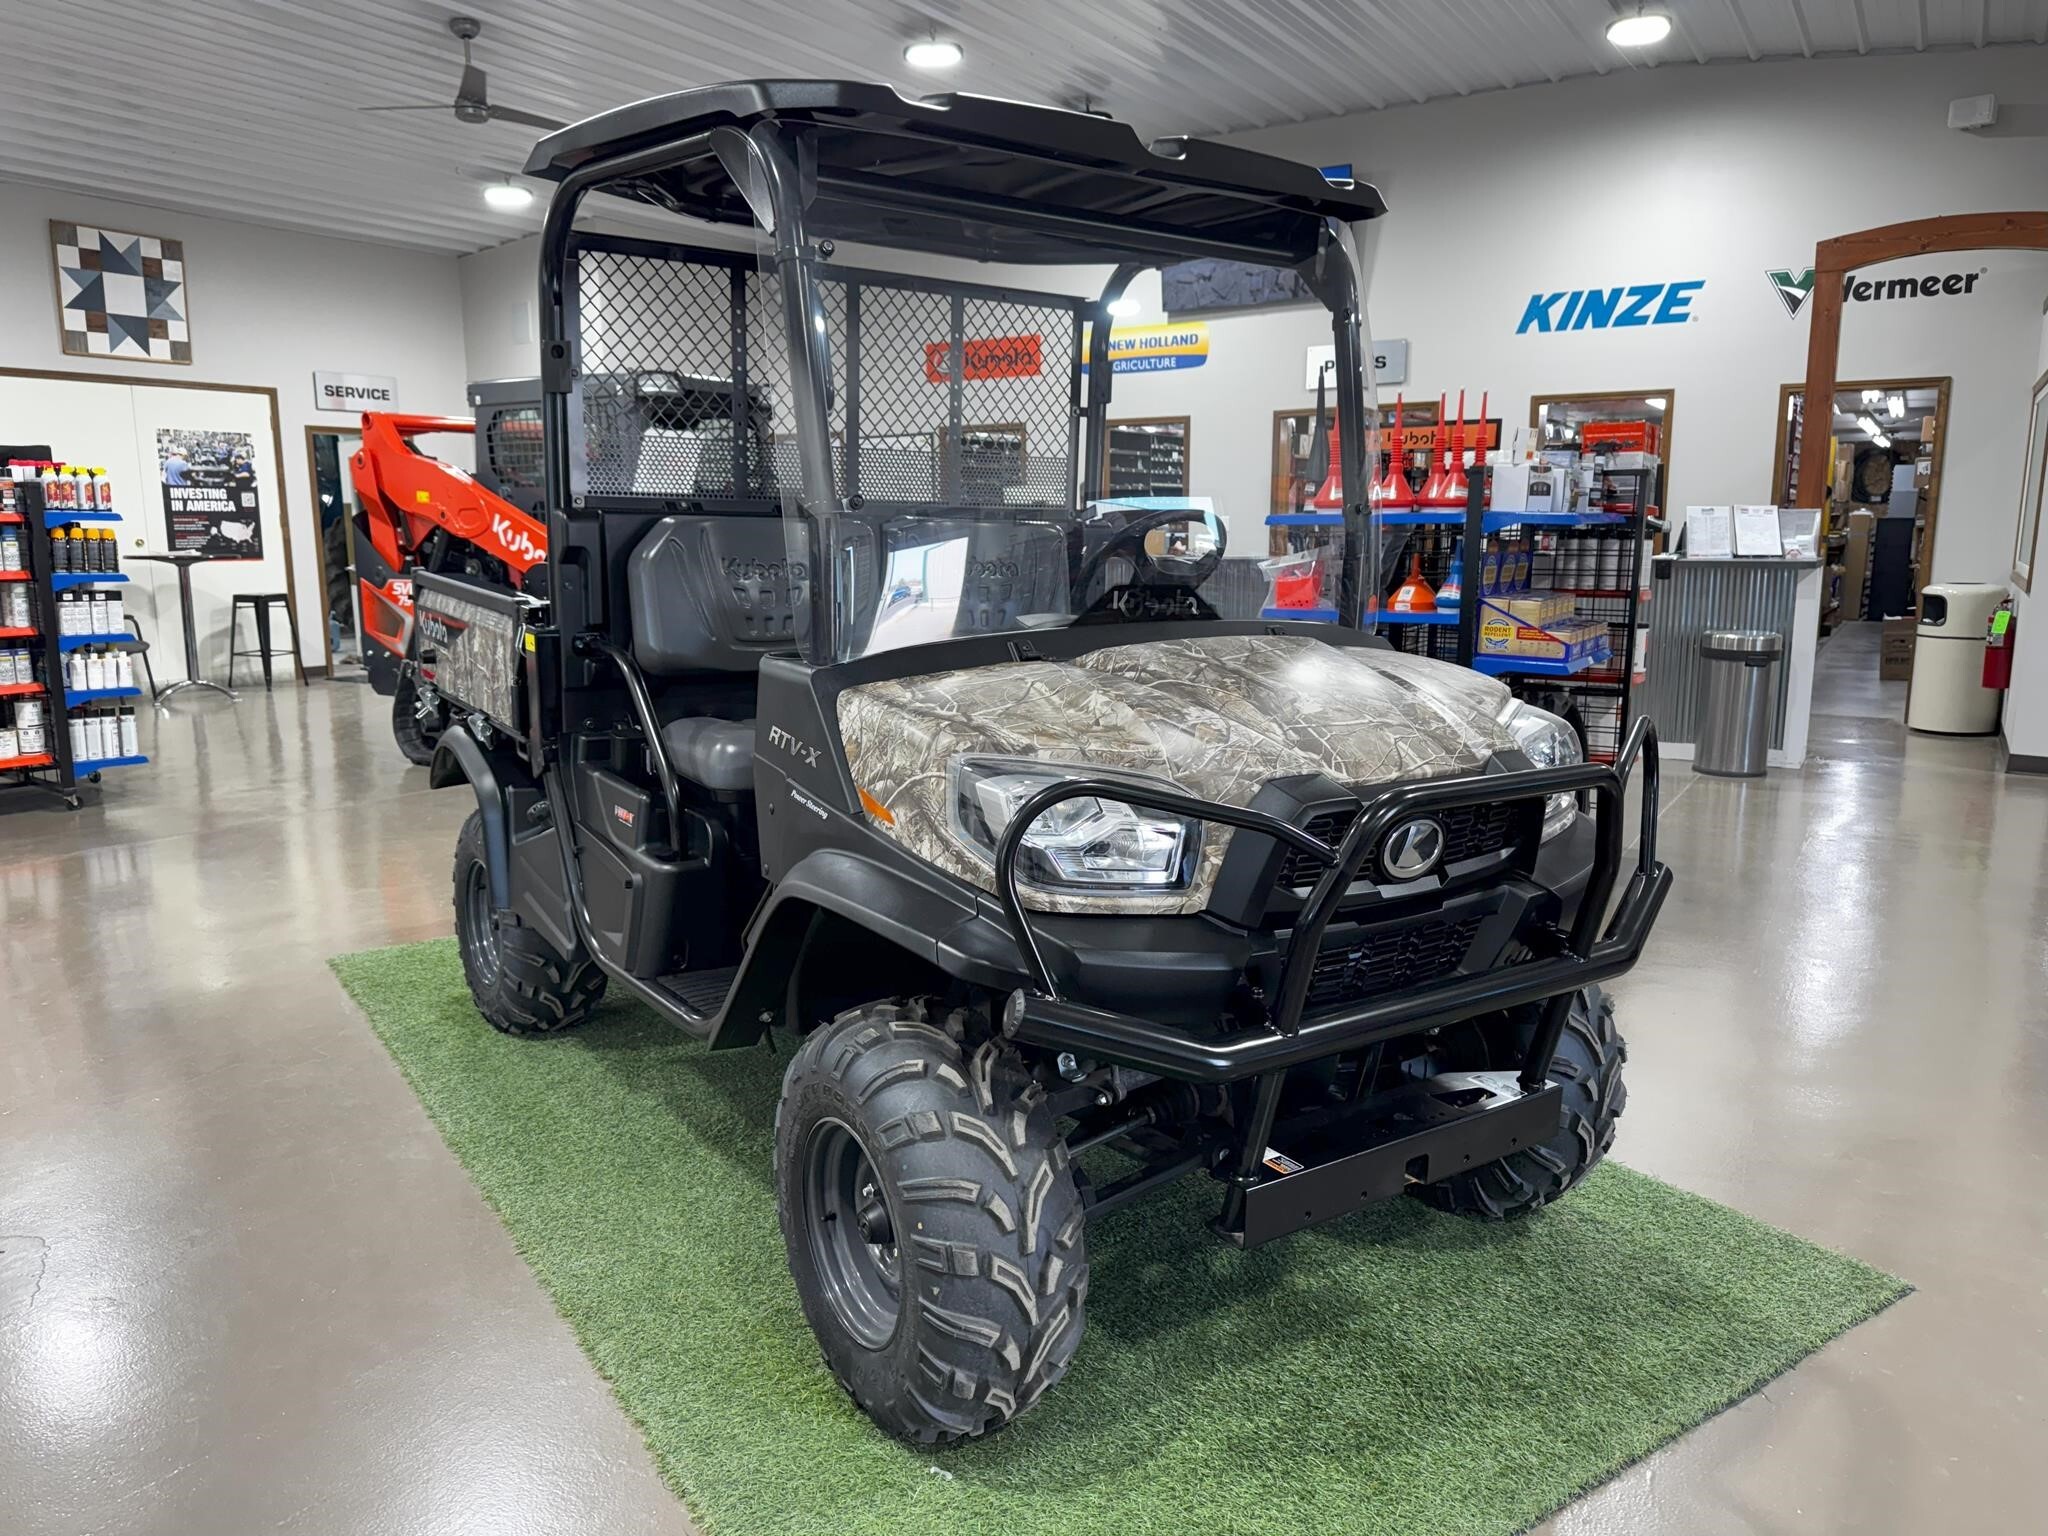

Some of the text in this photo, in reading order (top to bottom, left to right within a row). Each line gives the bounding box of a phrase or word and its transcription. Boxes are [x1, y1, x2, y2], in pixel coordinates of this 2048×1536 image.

[1515, 279, 1706, 335] KINZE
[1108, 333, 1199, 352] NEW HOLLAND
[1112, 357, 1177, 372] GRICULTURE
[324, 384, 391, 401] SERVICE
[169, 487, 228, 500] INVESTING
[171, 500, 237, 512] IN AMERICA
[419, 609, 448, 643] Kubota
[768, 725, 821, 768] RTV-X
[805, 800, 829, 820] Steering
